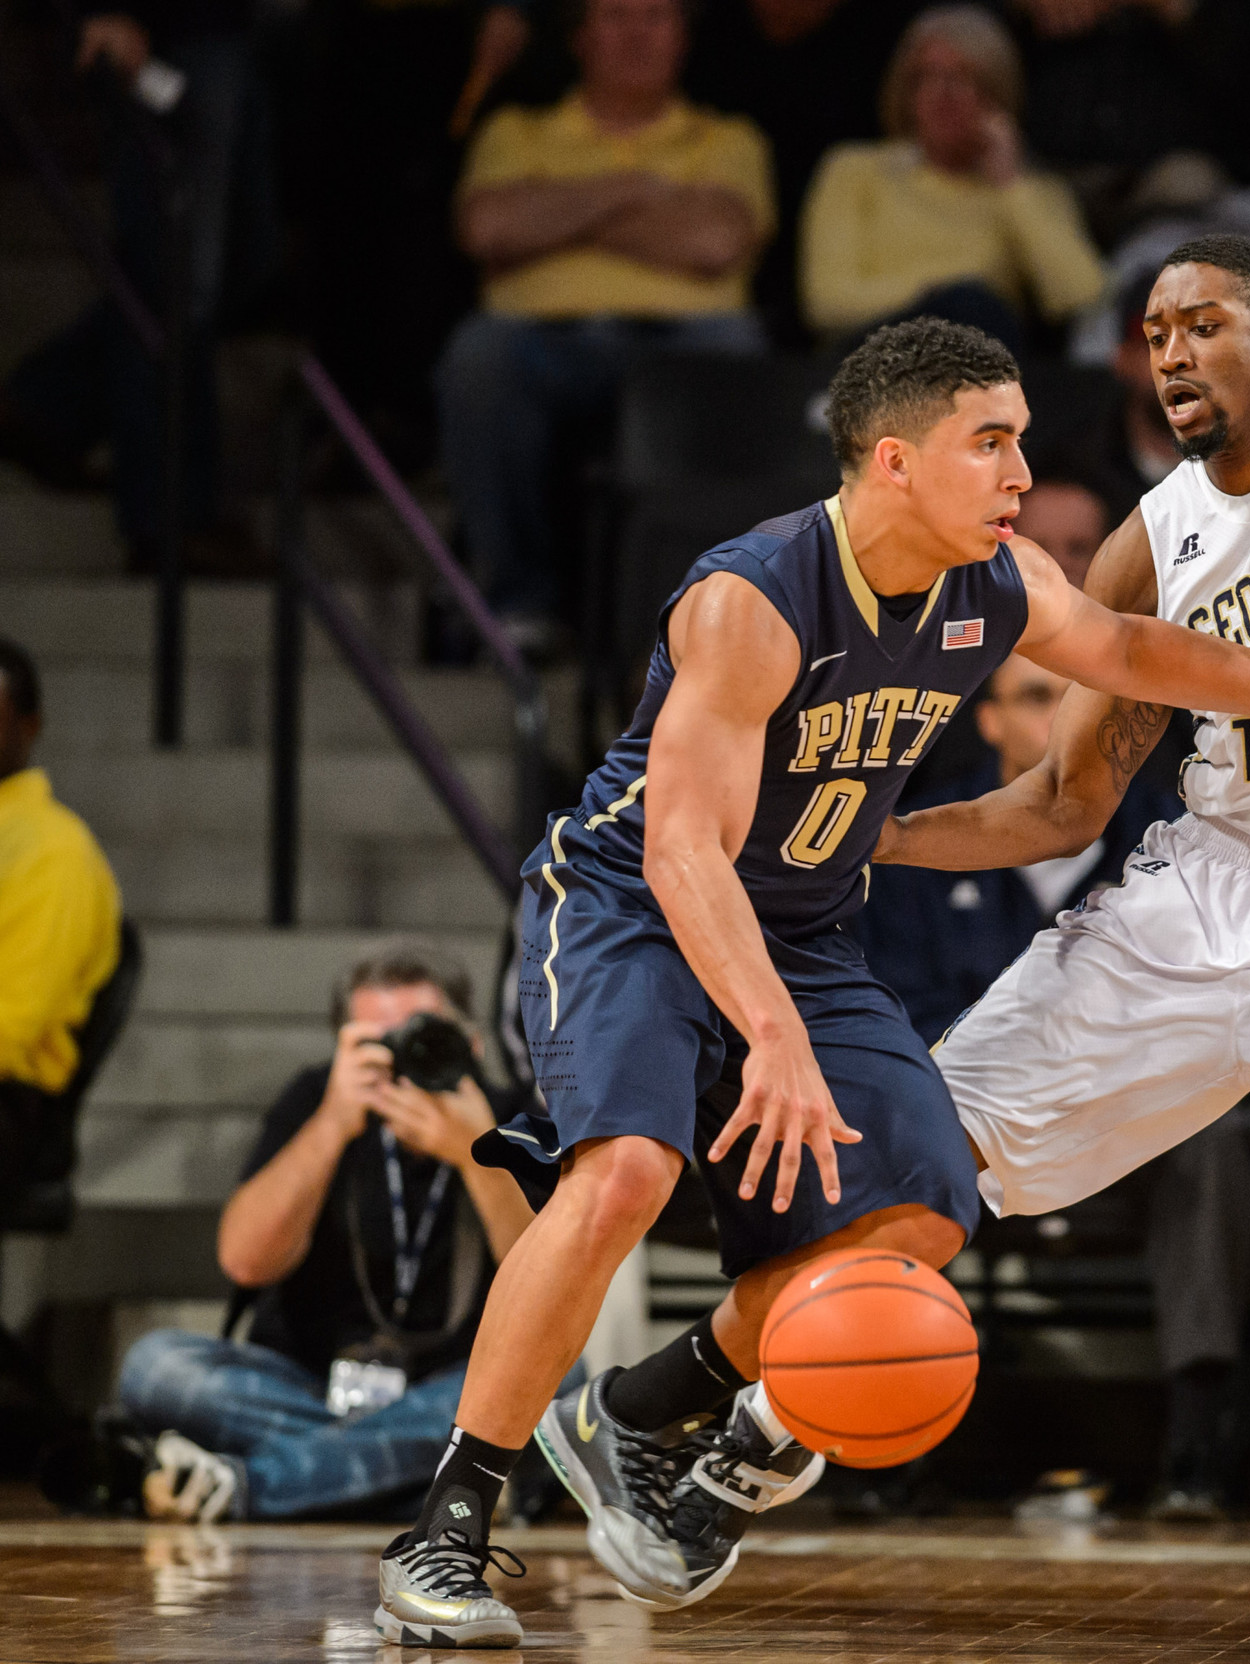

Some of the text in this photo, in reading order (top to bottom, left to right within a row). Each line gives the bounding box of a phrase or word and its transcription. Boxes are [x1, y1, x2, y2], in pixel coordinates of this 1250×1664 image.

[1173, 548, 1206, 566] RUSSELL
[788, 687, 961, 772] PITT
[780, 777, 867, 869] 0
